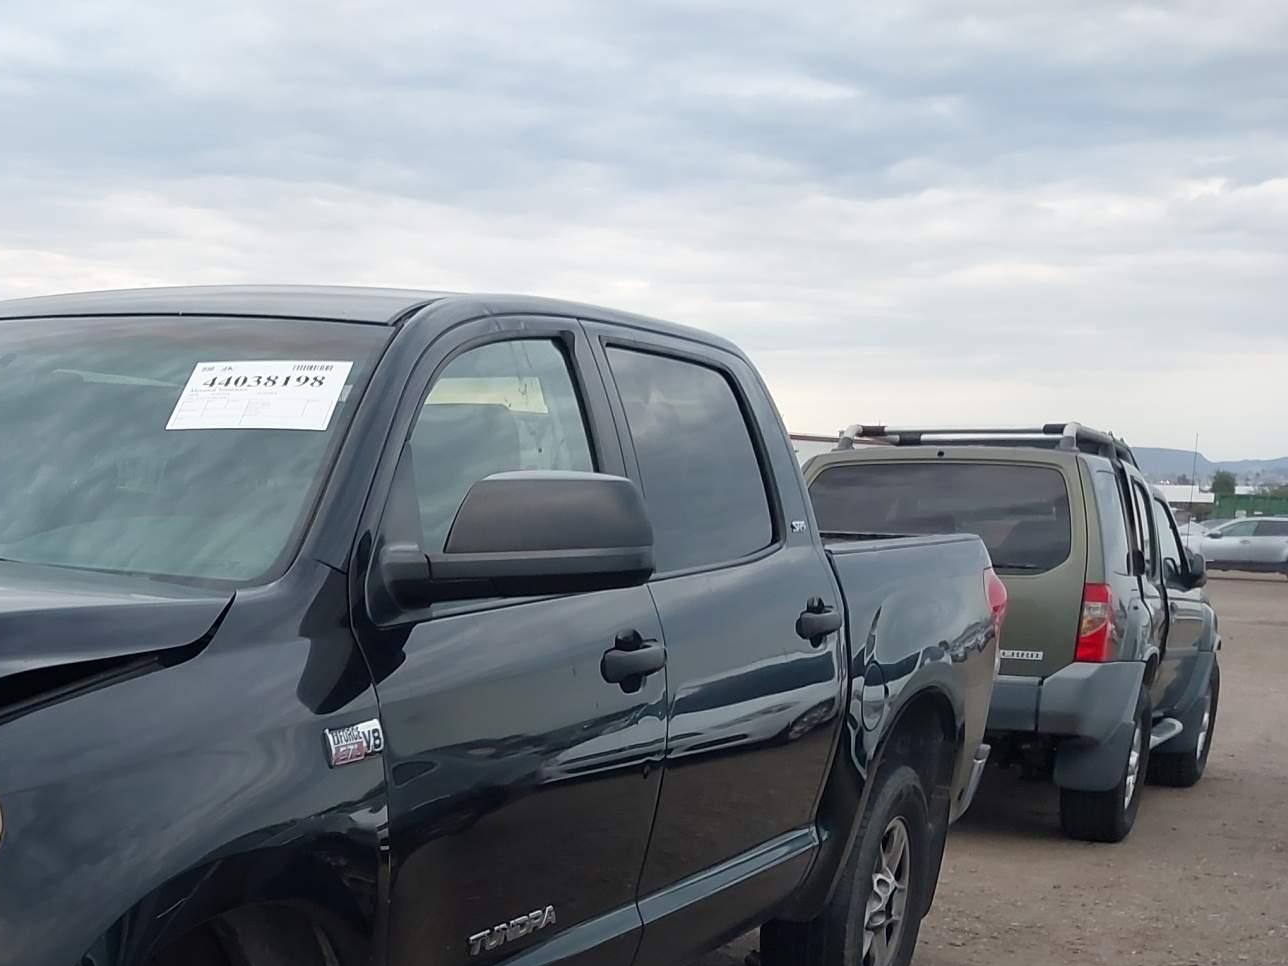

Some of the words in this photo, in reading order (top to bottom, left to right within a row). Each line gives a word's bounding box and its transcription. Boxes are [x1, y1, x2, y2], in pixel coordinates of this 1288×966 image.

[201, 374, 327, 388] 44038198
[361, 728, 382, 752] V8
[468, 905, 557, 956] TUNDRA
